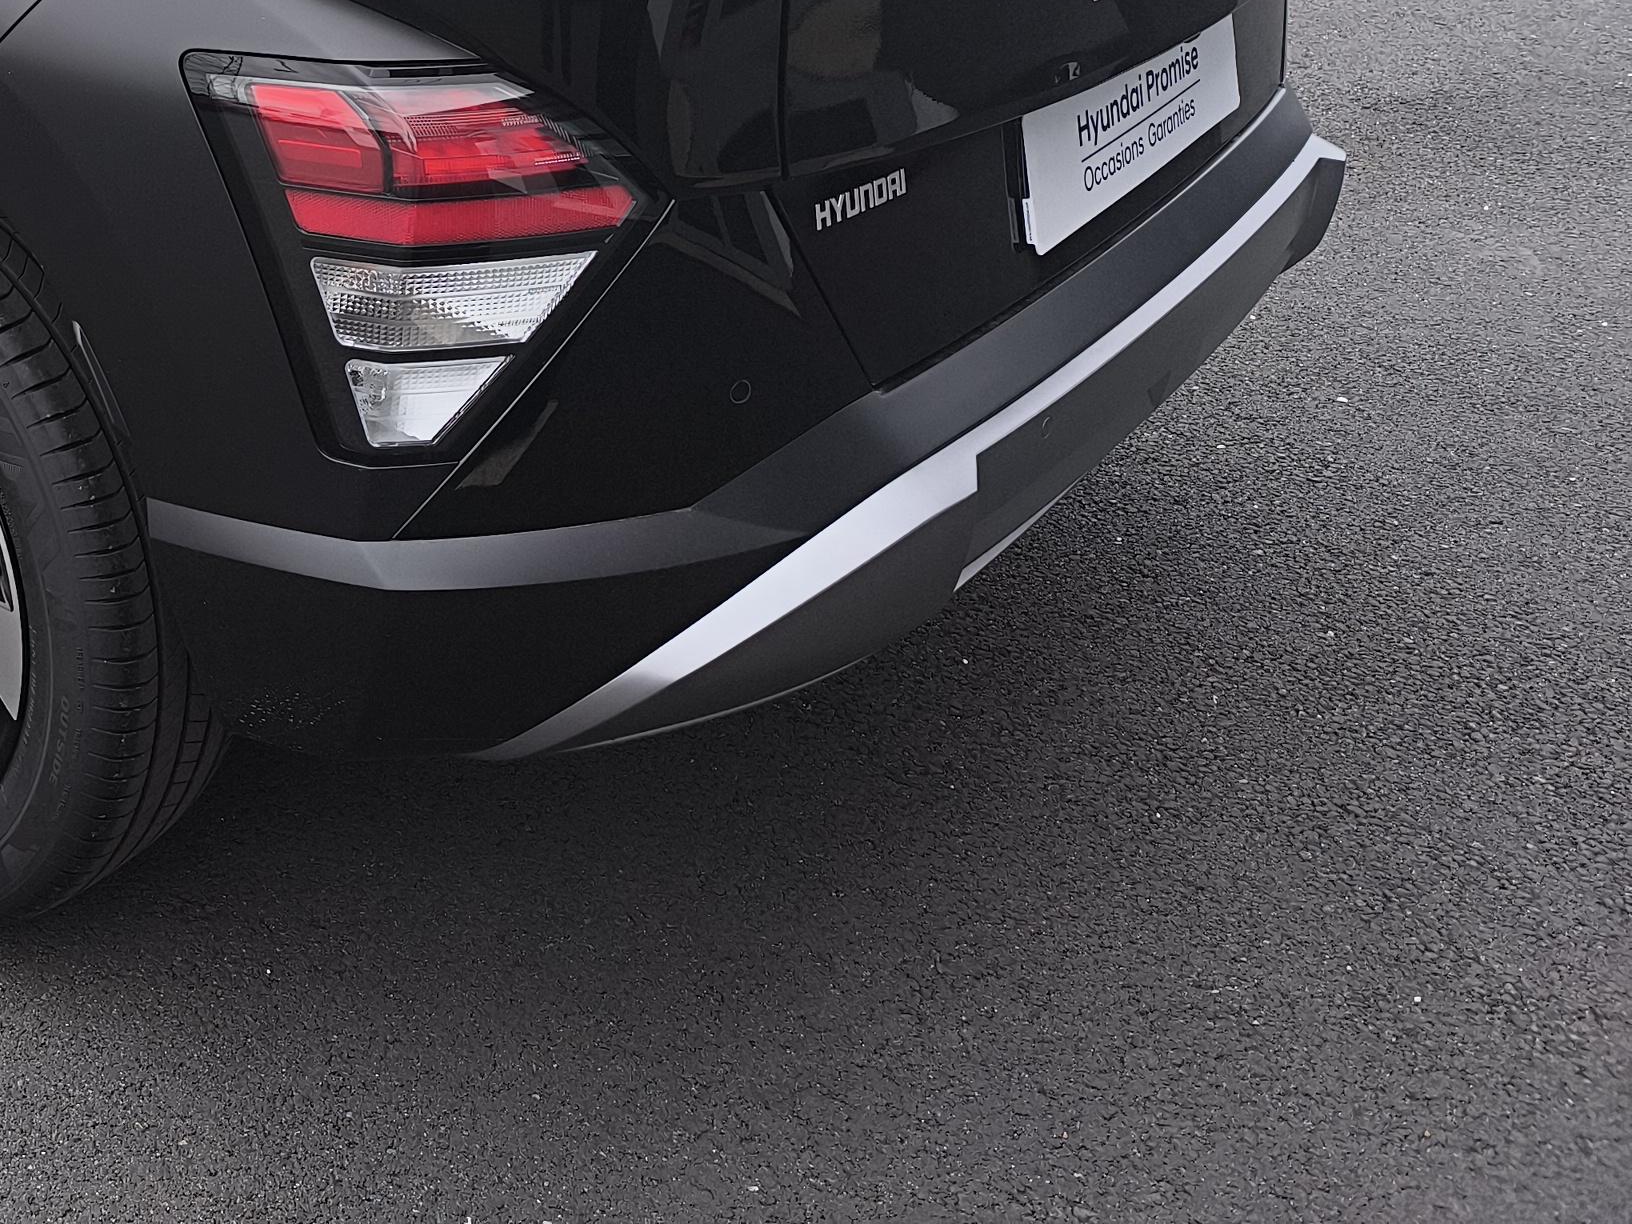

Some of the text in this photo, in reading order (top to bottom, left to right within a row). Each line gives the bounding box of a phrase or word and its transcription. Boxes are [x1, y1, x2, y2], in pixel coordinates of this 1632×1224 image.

[1077, 45, 1199, 147] Hyundai Promise
[1084, 98, 1196, 191] Occasions Garanties
[815, 167, 907, 231] HYUNDAI
[48, 695, 69, 785] OUTSIDE
